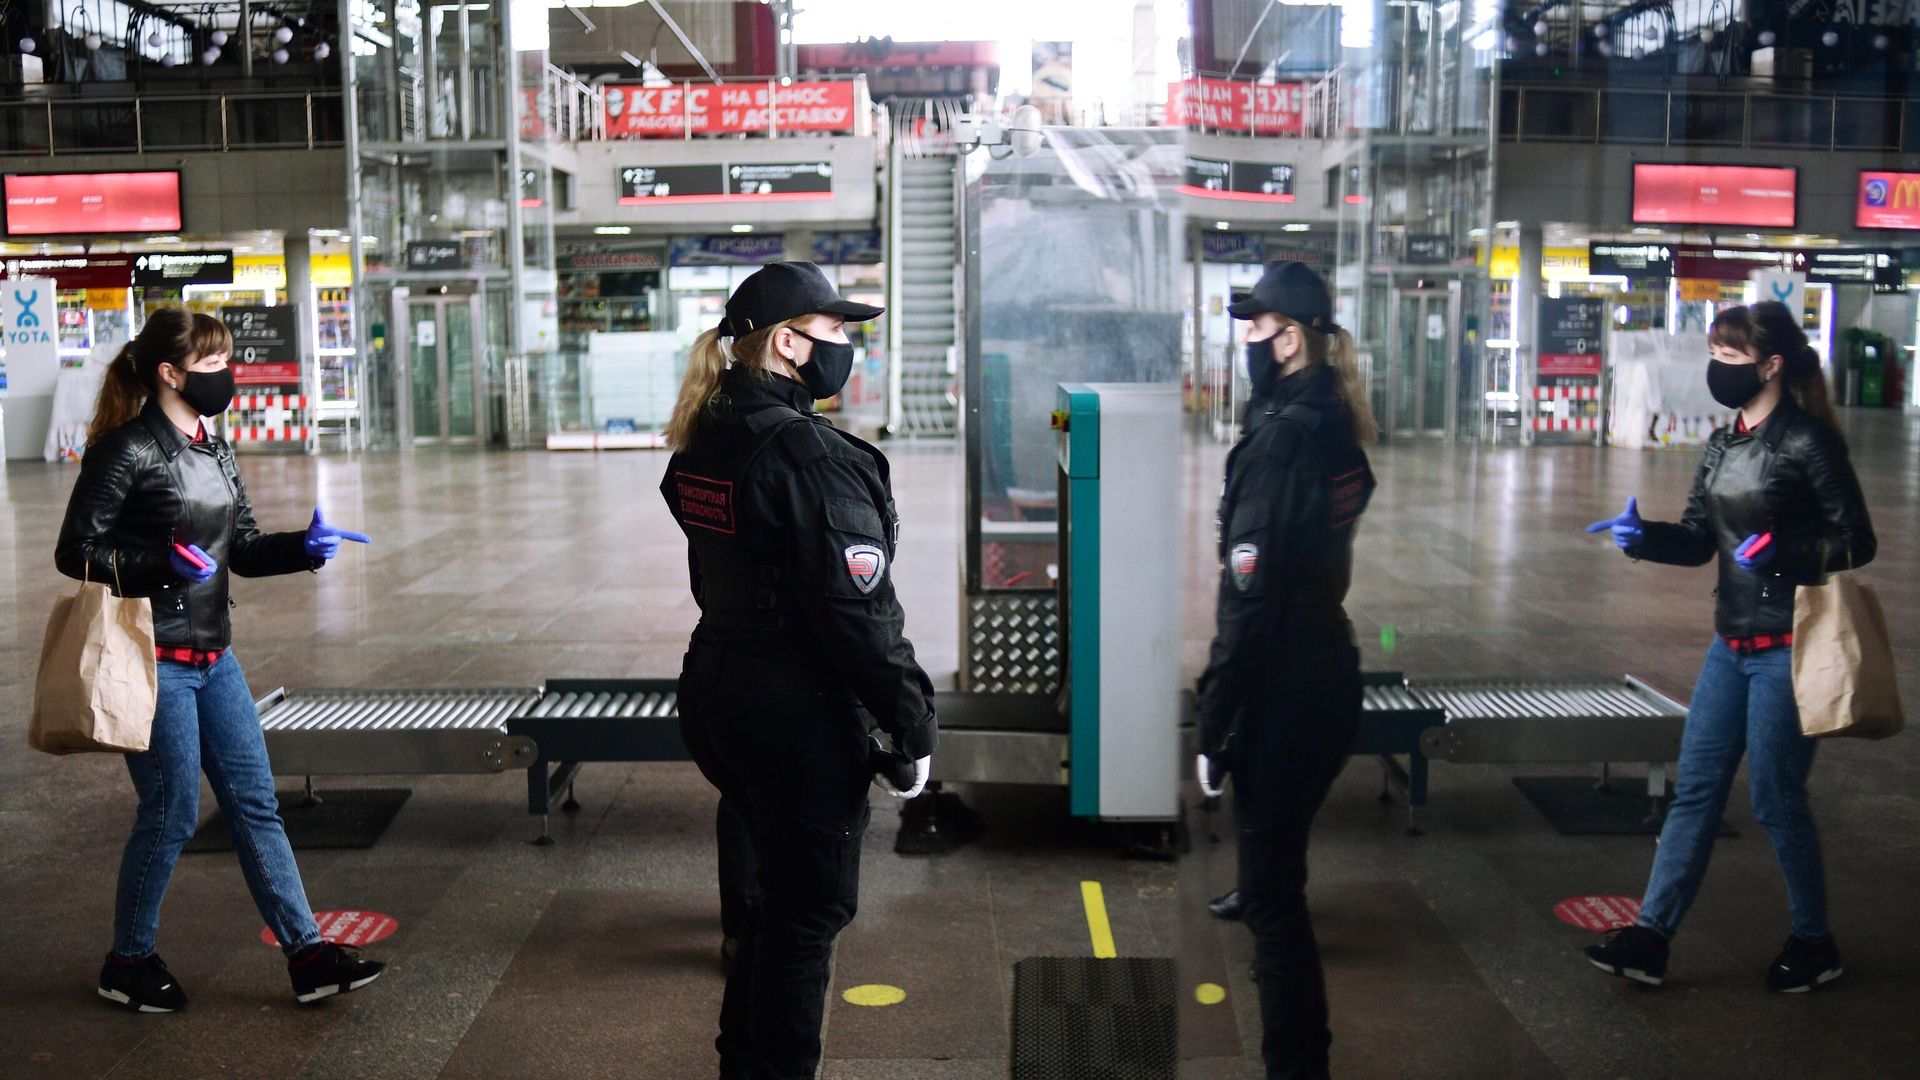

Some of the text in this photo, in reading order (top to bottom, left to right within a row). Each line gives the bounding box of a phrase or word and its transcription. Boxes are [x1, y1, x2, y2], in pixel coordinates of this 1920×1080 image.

[628, 88, 709, 113] KFC
[722, 86, 829, 106] НА ВЫНОС
[722, 107, 848, 129] И ДОСТАВКУ
[242, 312, 253, 330] 2
[9, 331, 49, 343] YOTA
[244, 346, 256, 364] 0
[680, 500, 727, 522] ЕЗОПАСНОСТЬ
